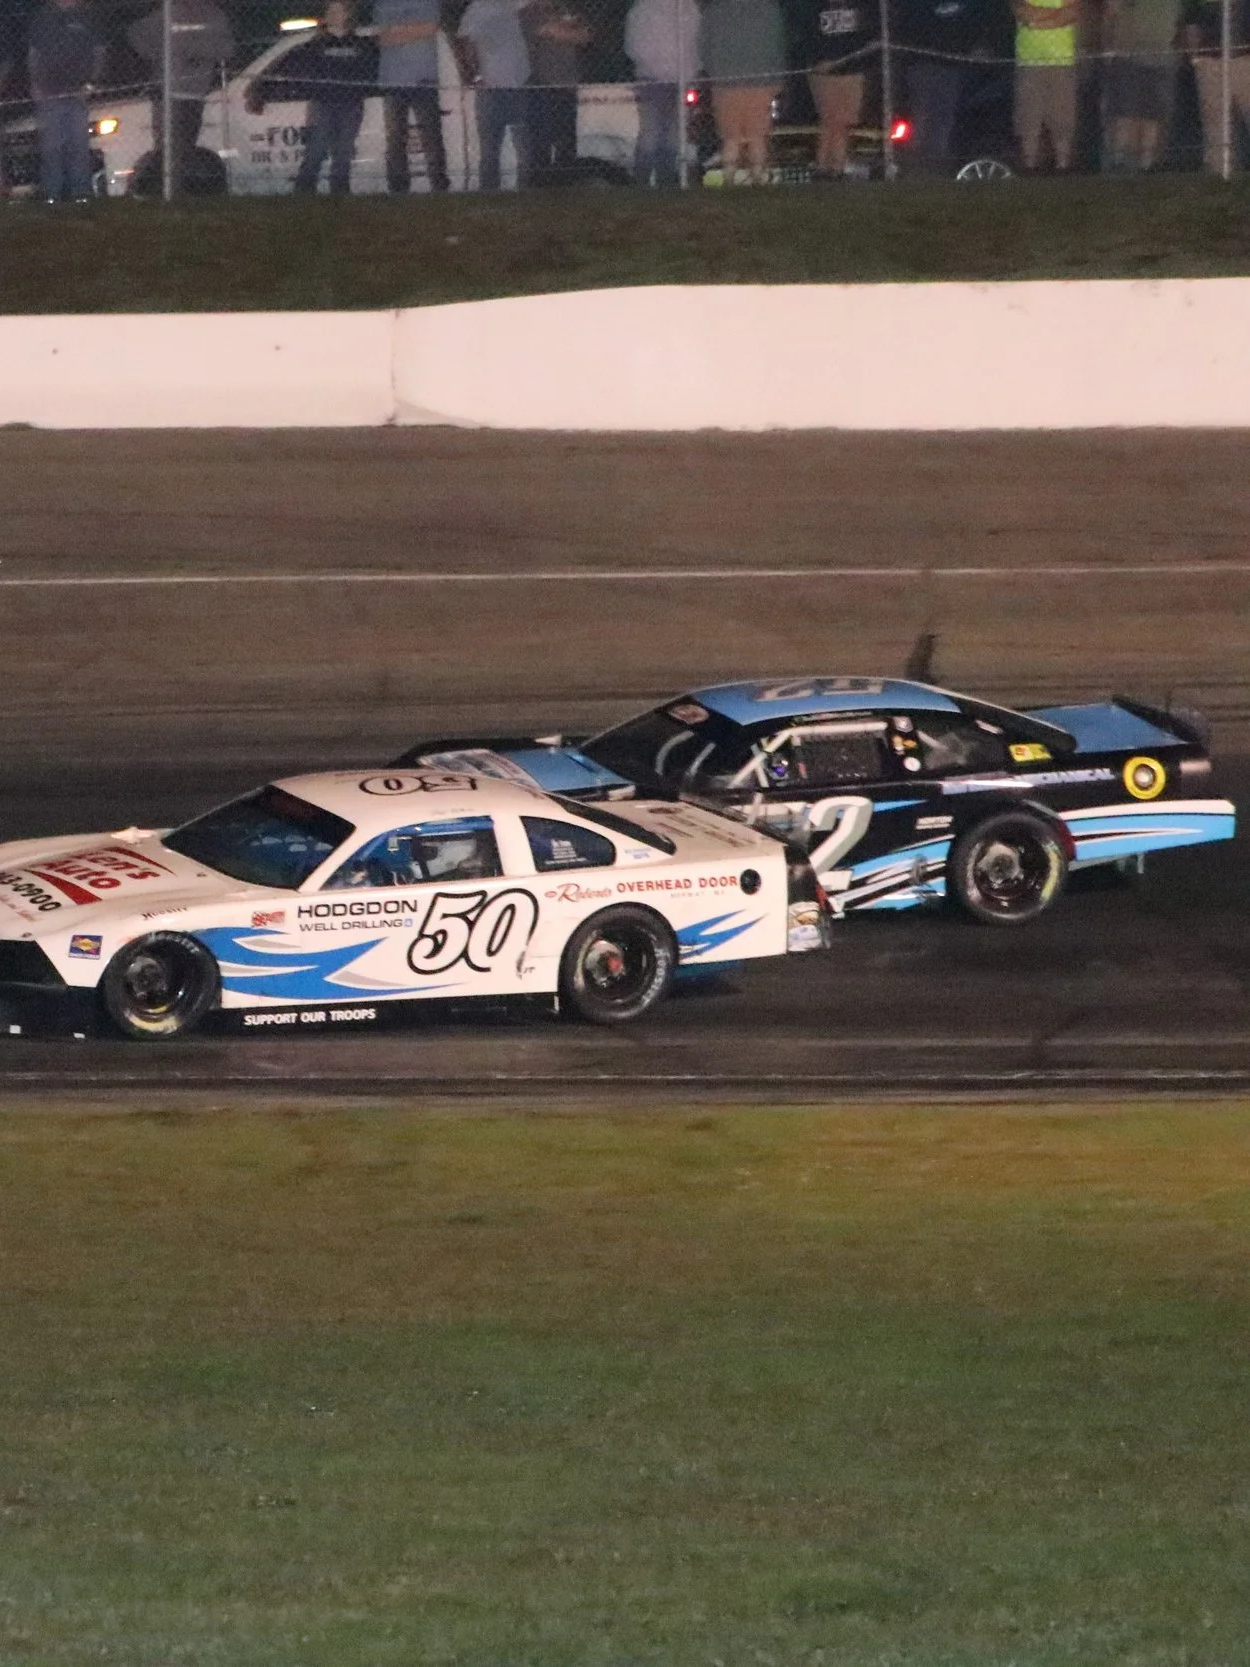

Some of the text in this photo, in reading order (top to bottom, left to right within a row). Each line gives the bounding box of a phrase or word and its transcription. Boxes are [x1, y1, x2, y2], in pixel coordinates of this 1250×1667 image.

[616, 878, 693, 893] OVERHEAD
[699, 876, 738, 888] DOOR
[297, 900, 418, 918] HODGDON
[299, 918, 403, 932] WELL DRILLING
[407, 887, 540, 979] 50
[244, 1008, 377, 1026] SUPPORT OUR TROOPS
